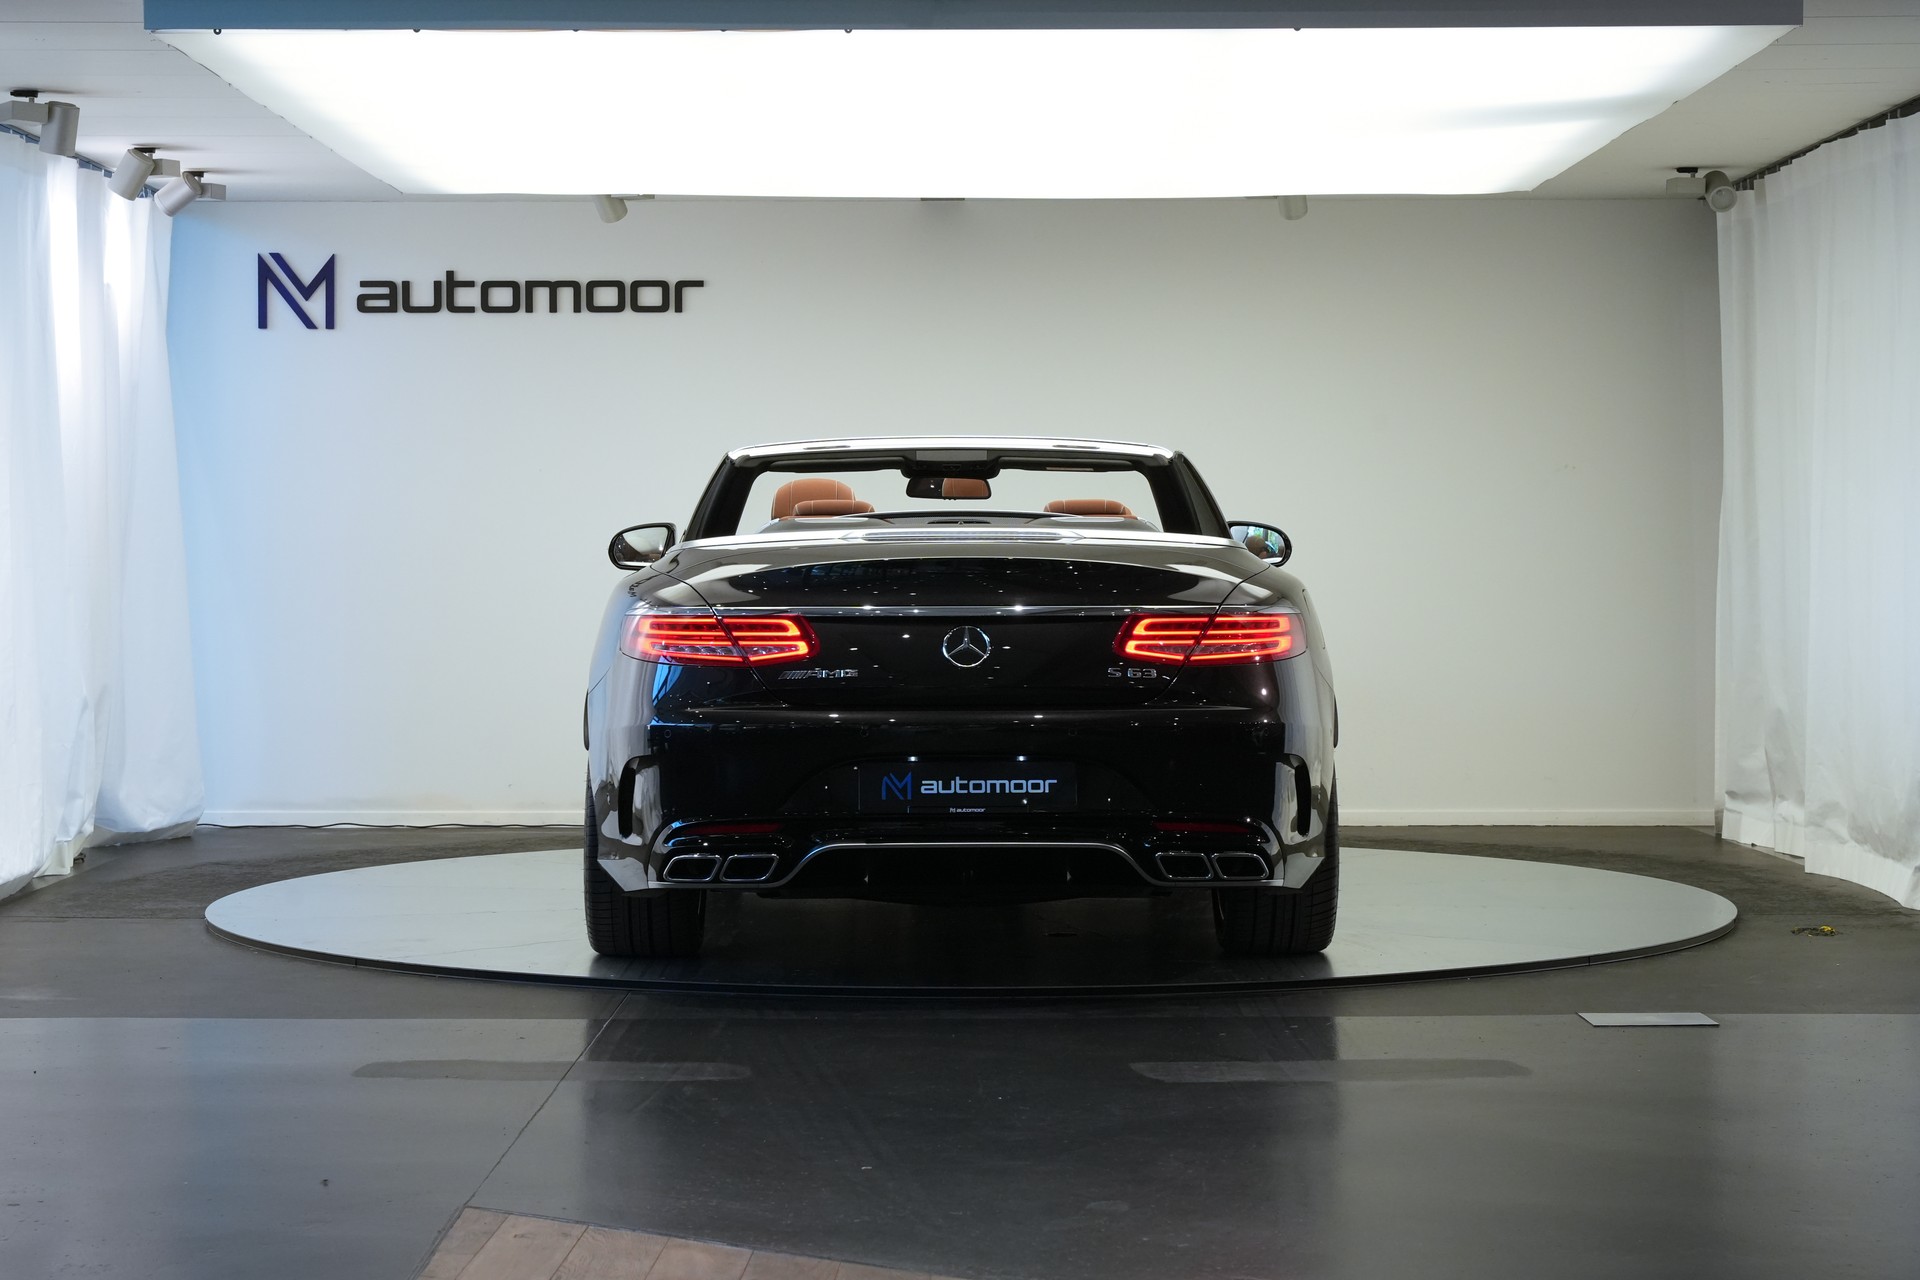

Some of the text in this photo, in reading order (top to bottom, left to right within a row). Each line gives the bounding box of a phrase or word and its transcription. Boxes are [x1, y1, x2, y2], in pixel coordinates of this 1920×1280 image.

[356, 270, 704, 313] automoor
[801, 669, 859, 679] AMG
[1107, 667, 1157, 679] S 63
[920, 776, 1058, 794] automoor
